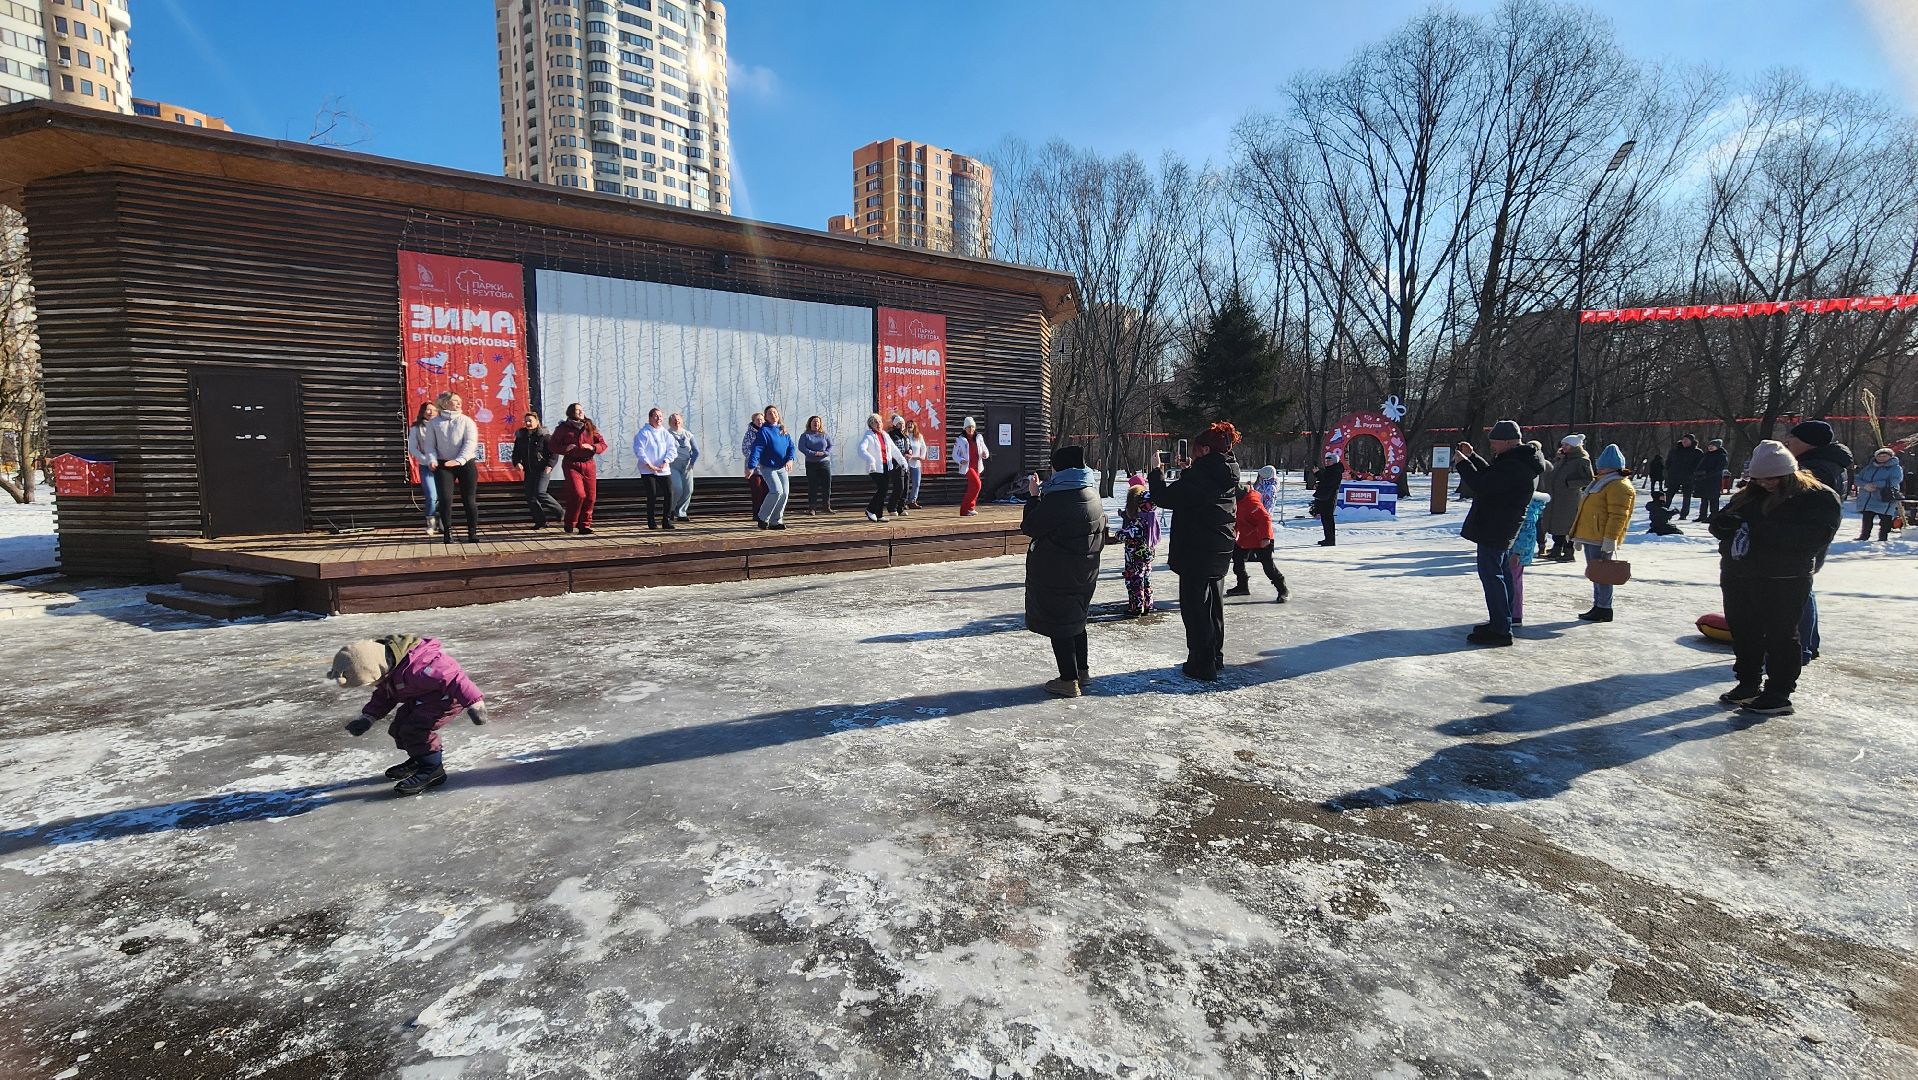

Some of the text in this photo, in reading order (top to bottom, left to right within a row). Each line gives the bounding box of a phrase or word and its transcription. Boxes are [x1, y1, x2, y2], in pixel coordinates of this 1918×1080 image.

[472, 282, 504, 291] ПАРКИ
[472, 289, 514, 298] РЕУТОВА
[410, 304, 516, 335] ЗИМА
[412, 333, 517, 348] В ПОДМОСКОВЬЕ
[884, 345, 940, 366] ЗИМА
[890, 366, 941, 376] ПОДМОСКОВЬЕ
